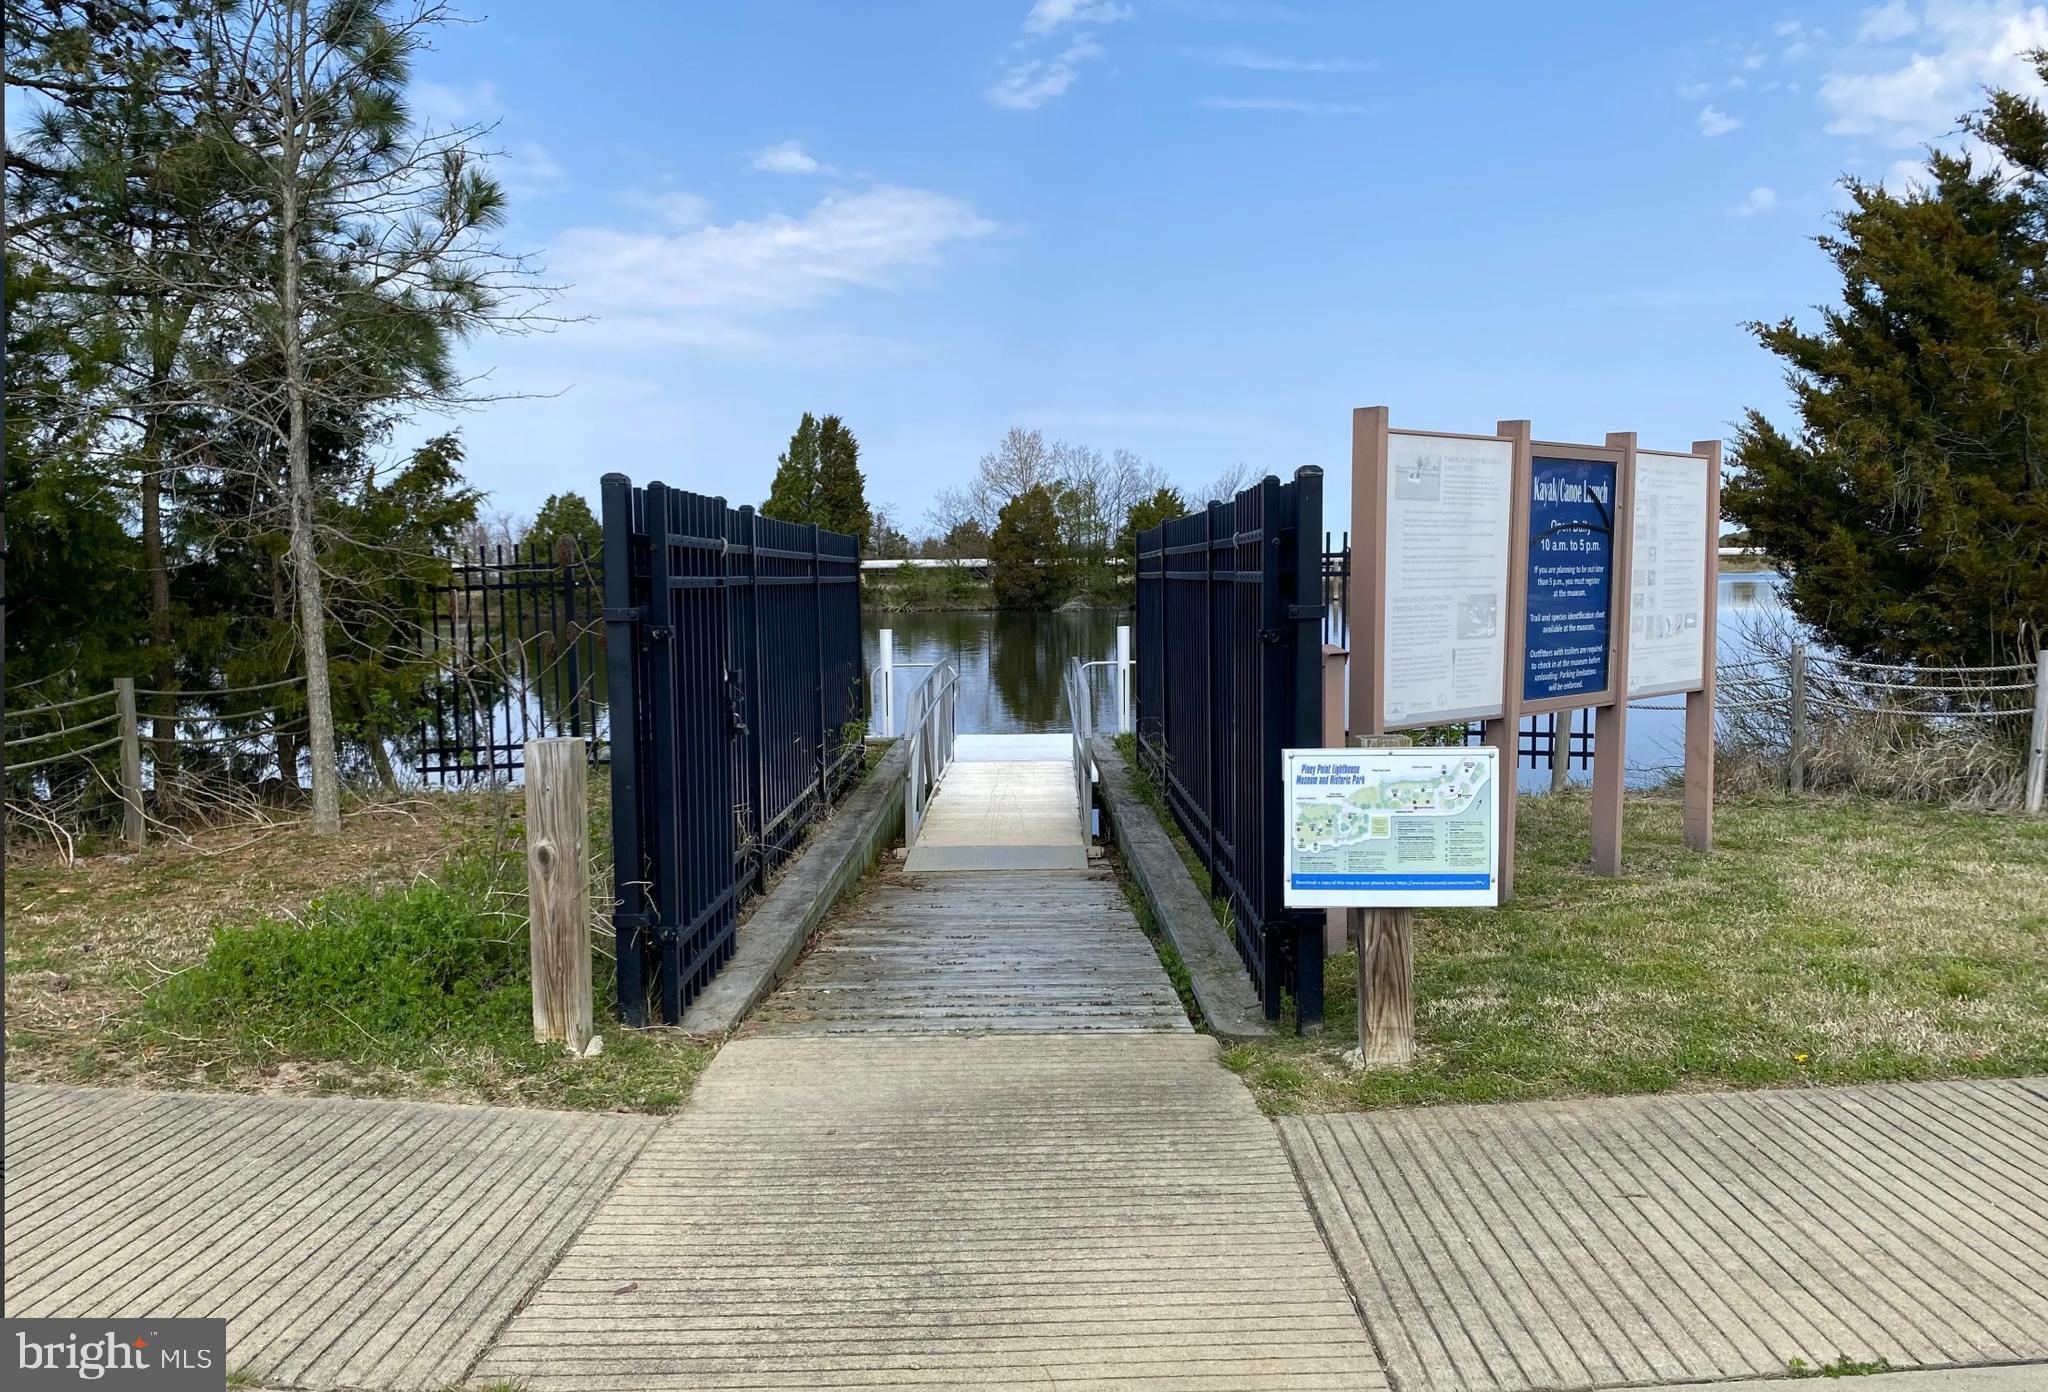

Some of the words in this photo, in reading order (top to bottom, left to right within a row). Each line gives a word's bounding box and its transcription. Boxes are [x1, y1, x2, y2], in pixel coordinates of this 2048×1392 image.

[1533, 476, 1582, 507] Kayak/Canoe
[1540, 538, 1550, 551] 10
[1552, 541, 1569, 551] a.m.
[1570, 539, 1578, 551] to
[1580, 539, 1585, 551] 5
[1586, 541, 1601, 554] p.m.
[1539, 567, 1548, 576] you
[1537, 578, 1548, 587] than
[1565, 579, 1574, 588] you
[1574, 578, 1584, 586] must
[1553, 590, 1558, 598] at
[1530, 613, 1541, 622] Trail
[1542, 613, 1550, 622] and
[1551, 613, 1567, 623] species
[1563, 624, 1568, 632] at
[1530, 648, 1553, 658] Outfitters
[1554, 647, 1564, 656] with
[1537, 660, 1551, 670] check
[1301, 764, 1316, 776] Piney
[1317, 764, 1331, 774] Point
[1332, 764, 1360, 776] Lighthouse
[1296, 775, 1318, 785] Museum
[1319, 775, 1329, 785] and
[1352, 775, 1365, 785] Park
